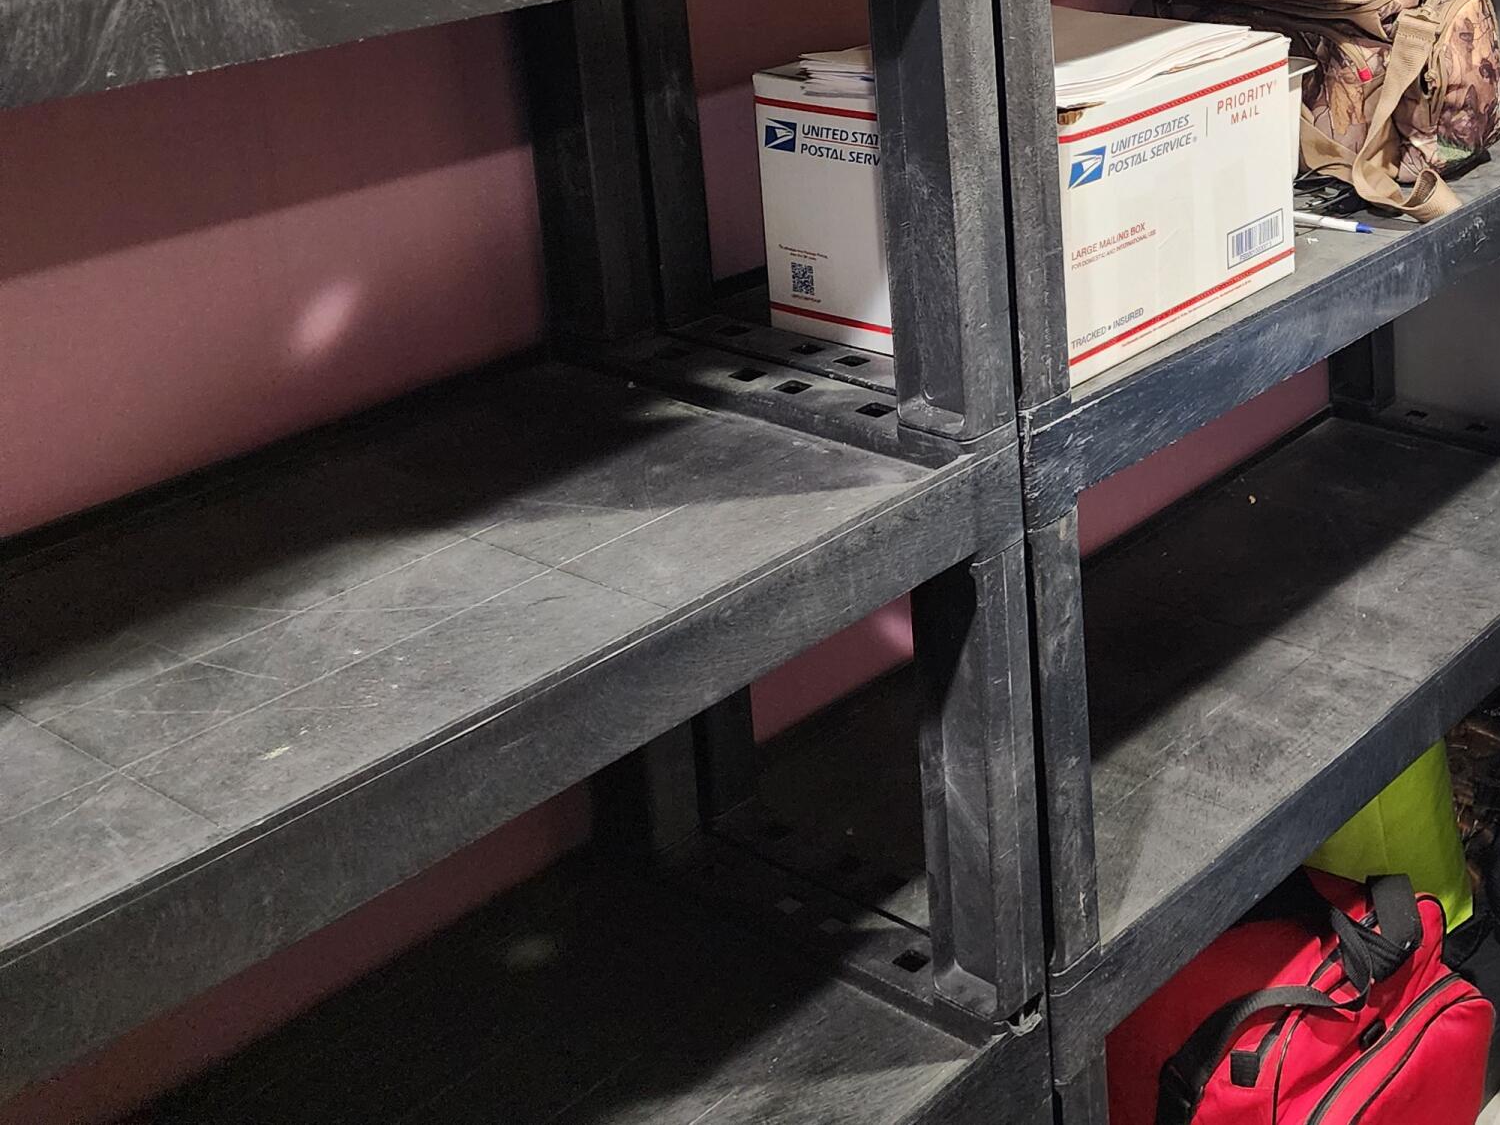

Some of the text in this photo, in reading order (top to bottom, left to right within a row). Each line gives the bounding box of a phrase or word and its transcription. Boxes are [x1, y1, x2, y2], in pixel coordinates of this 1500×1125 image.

[1217, 81, 1273, 114] PRIORITY
[1231, 108, 1260, 124] MAIL
[802, 124, 849, 141] UNITED
[1111, 114, 1190, 154] UNITED STATES
[801, 143, 881, 166] POSTAL SERV
[1108, 150, 1148, 176] POSTAL
[1071, 222, 1146, 261] LARGE MAILING BOX
[1071, 307, 1145, 350] TRACKED INSURED
